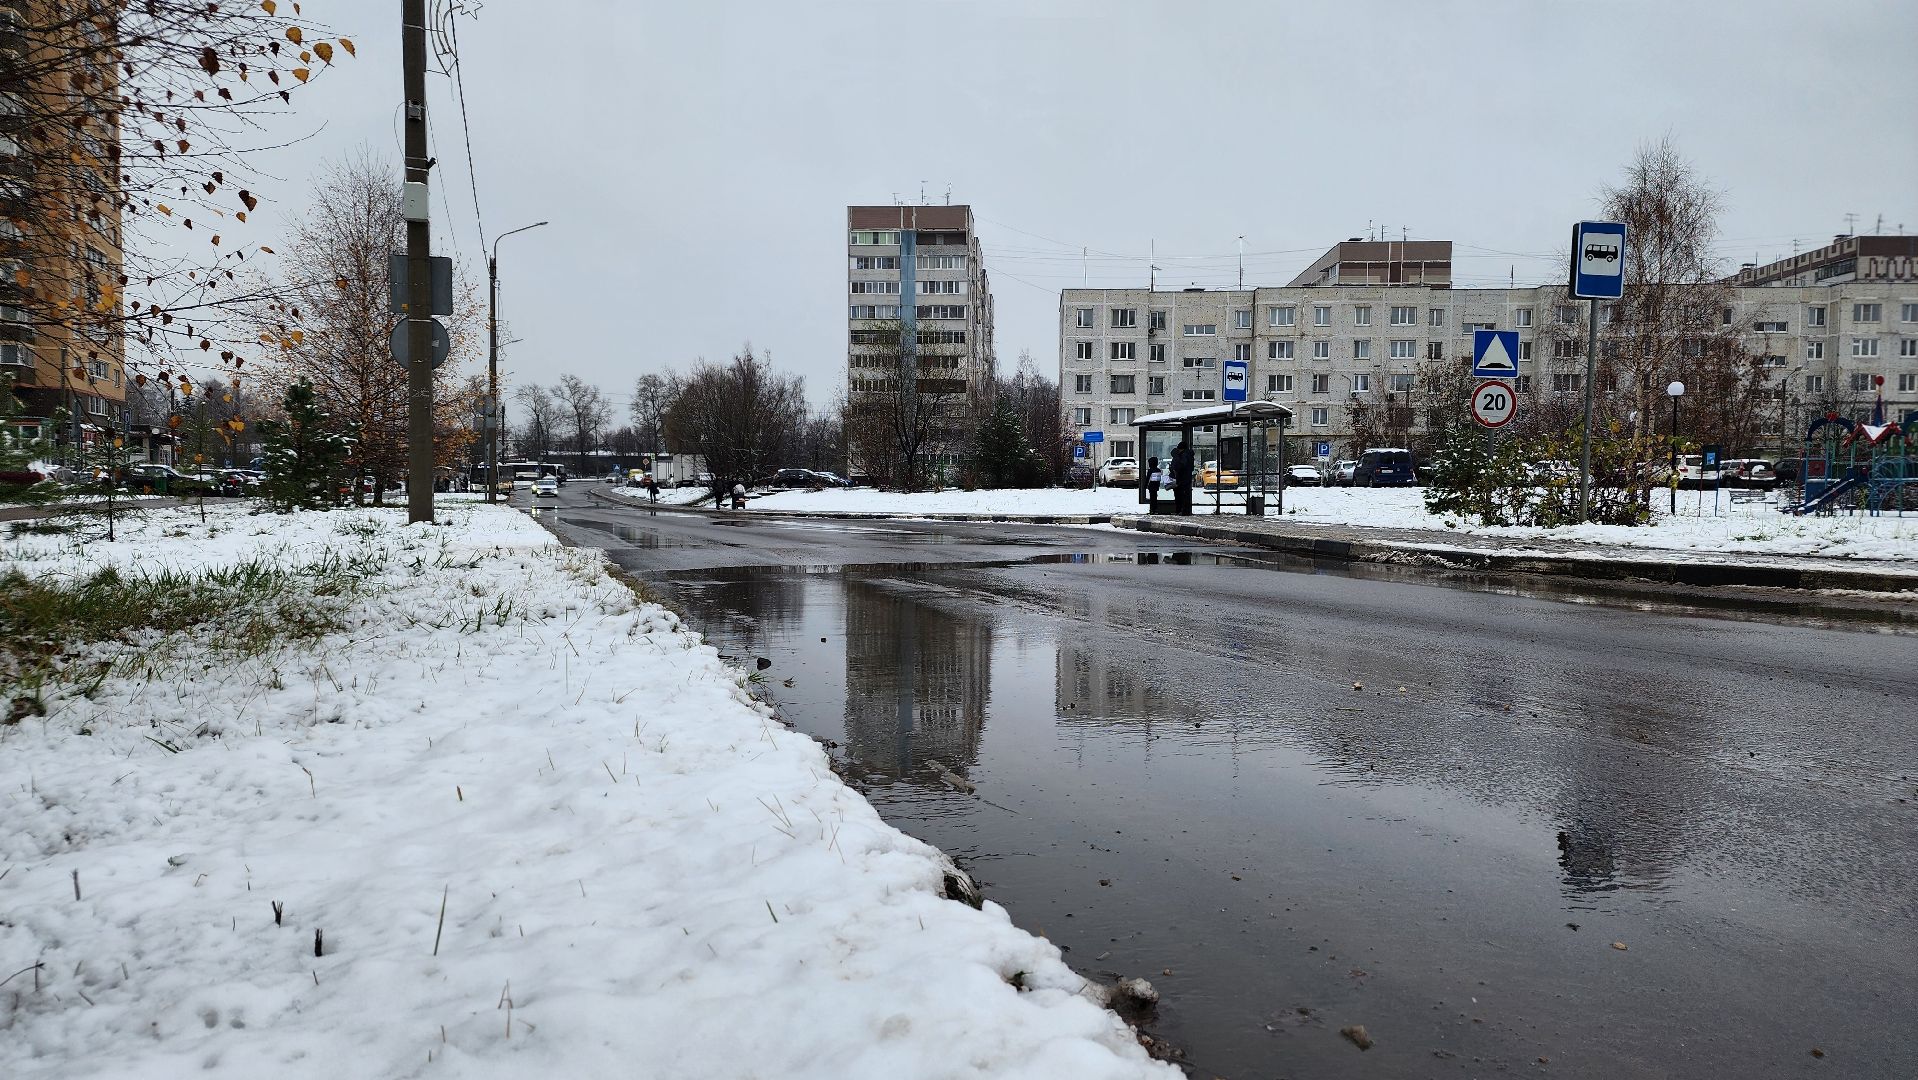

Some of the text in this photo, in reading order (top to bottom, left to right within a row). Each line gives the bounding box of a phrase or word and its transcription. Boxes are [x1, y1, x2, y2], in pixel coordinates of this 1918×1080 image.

[1482, 393, 1506, 411] 20
[1076, 447, 1083, 457] P
[1321, 444, 1328, 454] P
